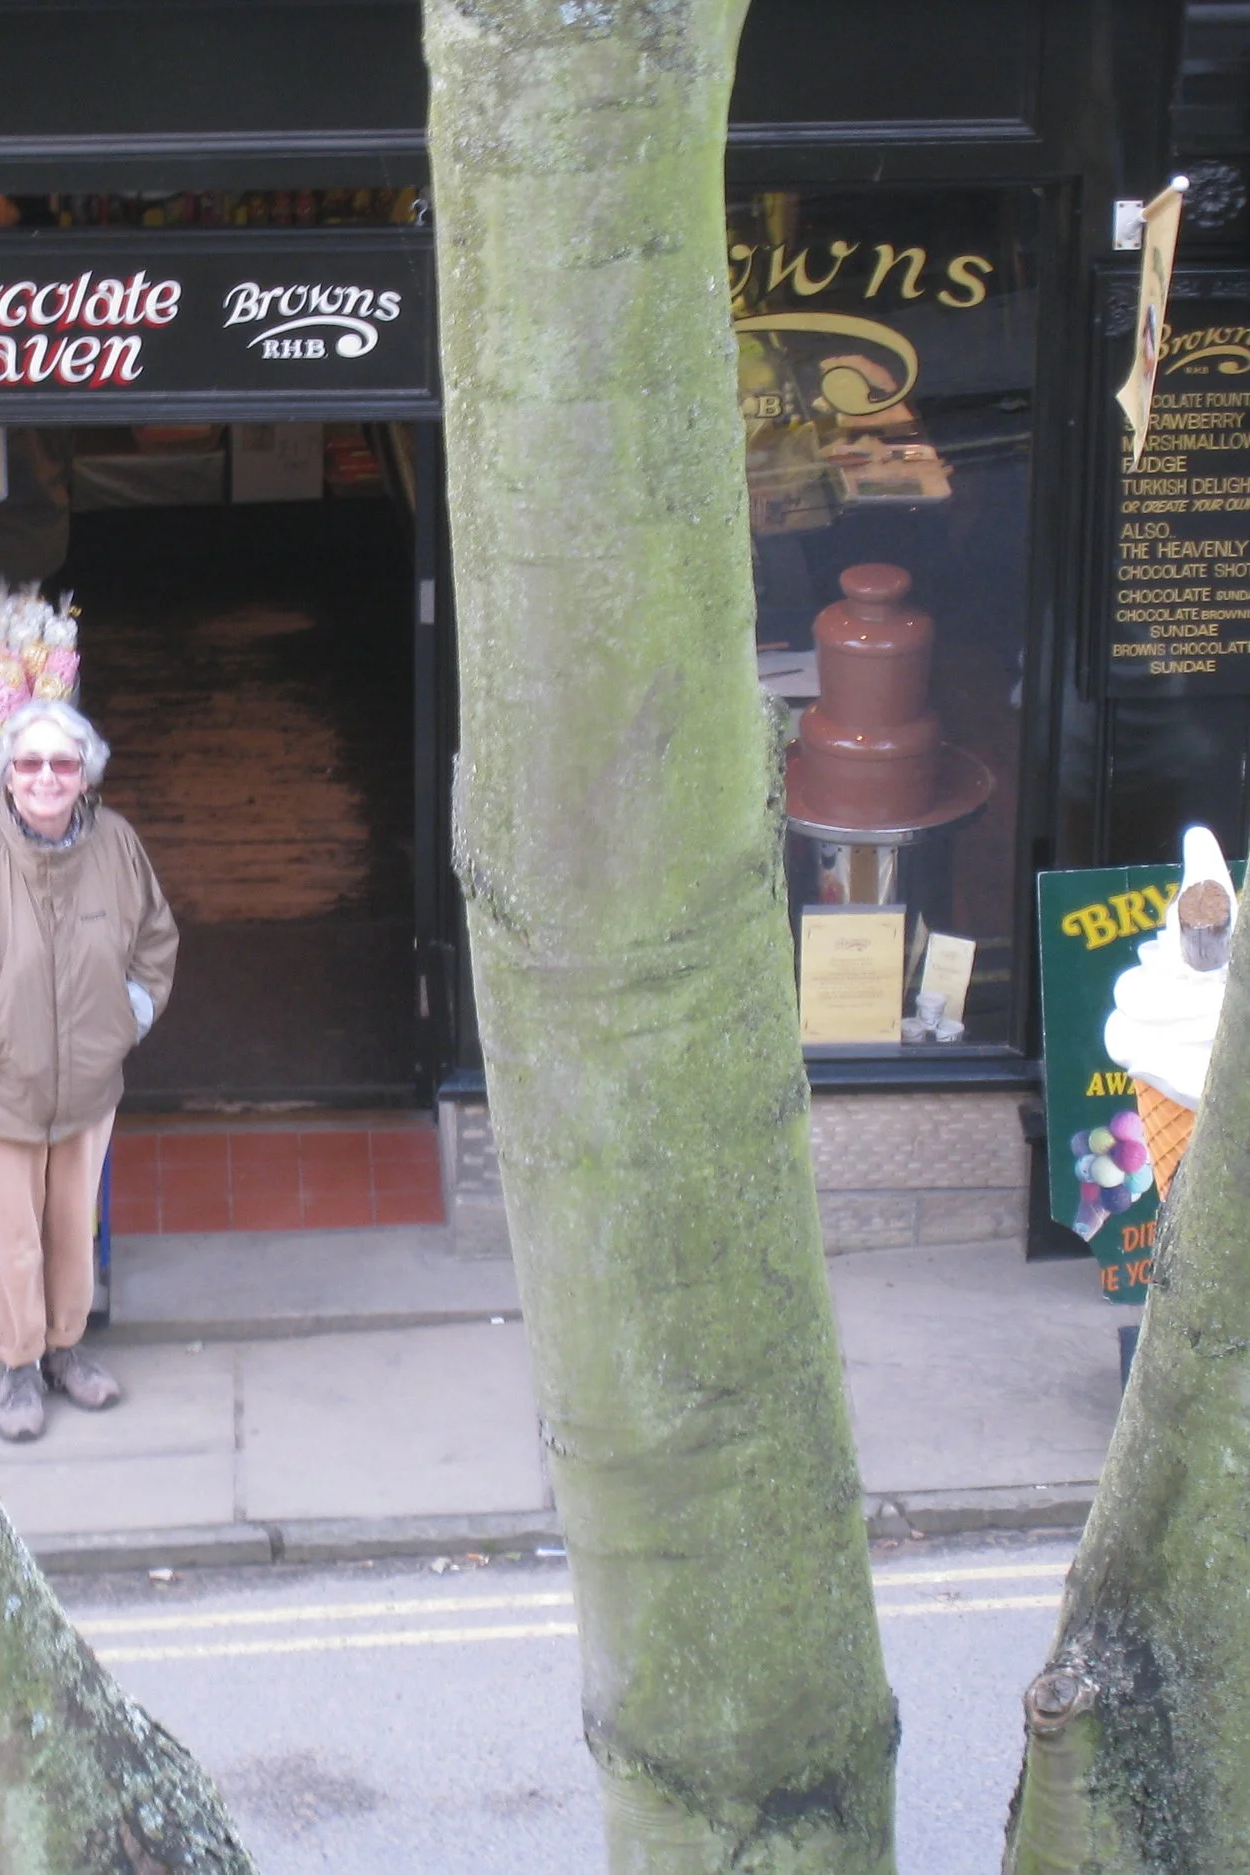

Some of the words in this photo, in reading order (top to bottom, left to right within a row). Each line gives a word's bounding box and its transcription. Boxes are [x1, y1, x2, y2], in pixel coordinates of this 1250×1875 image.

[728, 240, 994, 308] wns
[222, 281, 402, 329] Browns
[1152, 393, 1204, 409] COLATE
[1206, 392, 1250, 408] FOUNT
[1124, 412, 1246, 431] SRAWBERRY
[1122, 456, 1188, 474] FUDGE
[1122, 478, 1187, 496] TURKISH
[1192, 476, 1250, 495] DELIGH
[1122, 500, 1141, 513] OR
[1142, 499, 1190, 513] CREATE
[1191, 499, 1224, 512] YOUR
[1119, 542, 1150, 559] THE
[1157, 540, 1249, 558] HEAVENLY
[1117, 564, 1208, 581] CHOCOLATE
[1117, 587, 1211, 604] CHOCOLATE
[1116, 608, 1200, 622] CHOCOLATE
[1201, 608, 1250, 620] BROWNI
[1150, 624, 1219, 638] SUNDAE
[1113, 643, 1167, 657] BROWNS
[1170, 641, 1250, 655] CHOCOLAT
[1150, 660, 1216, 674] SUNDAE
